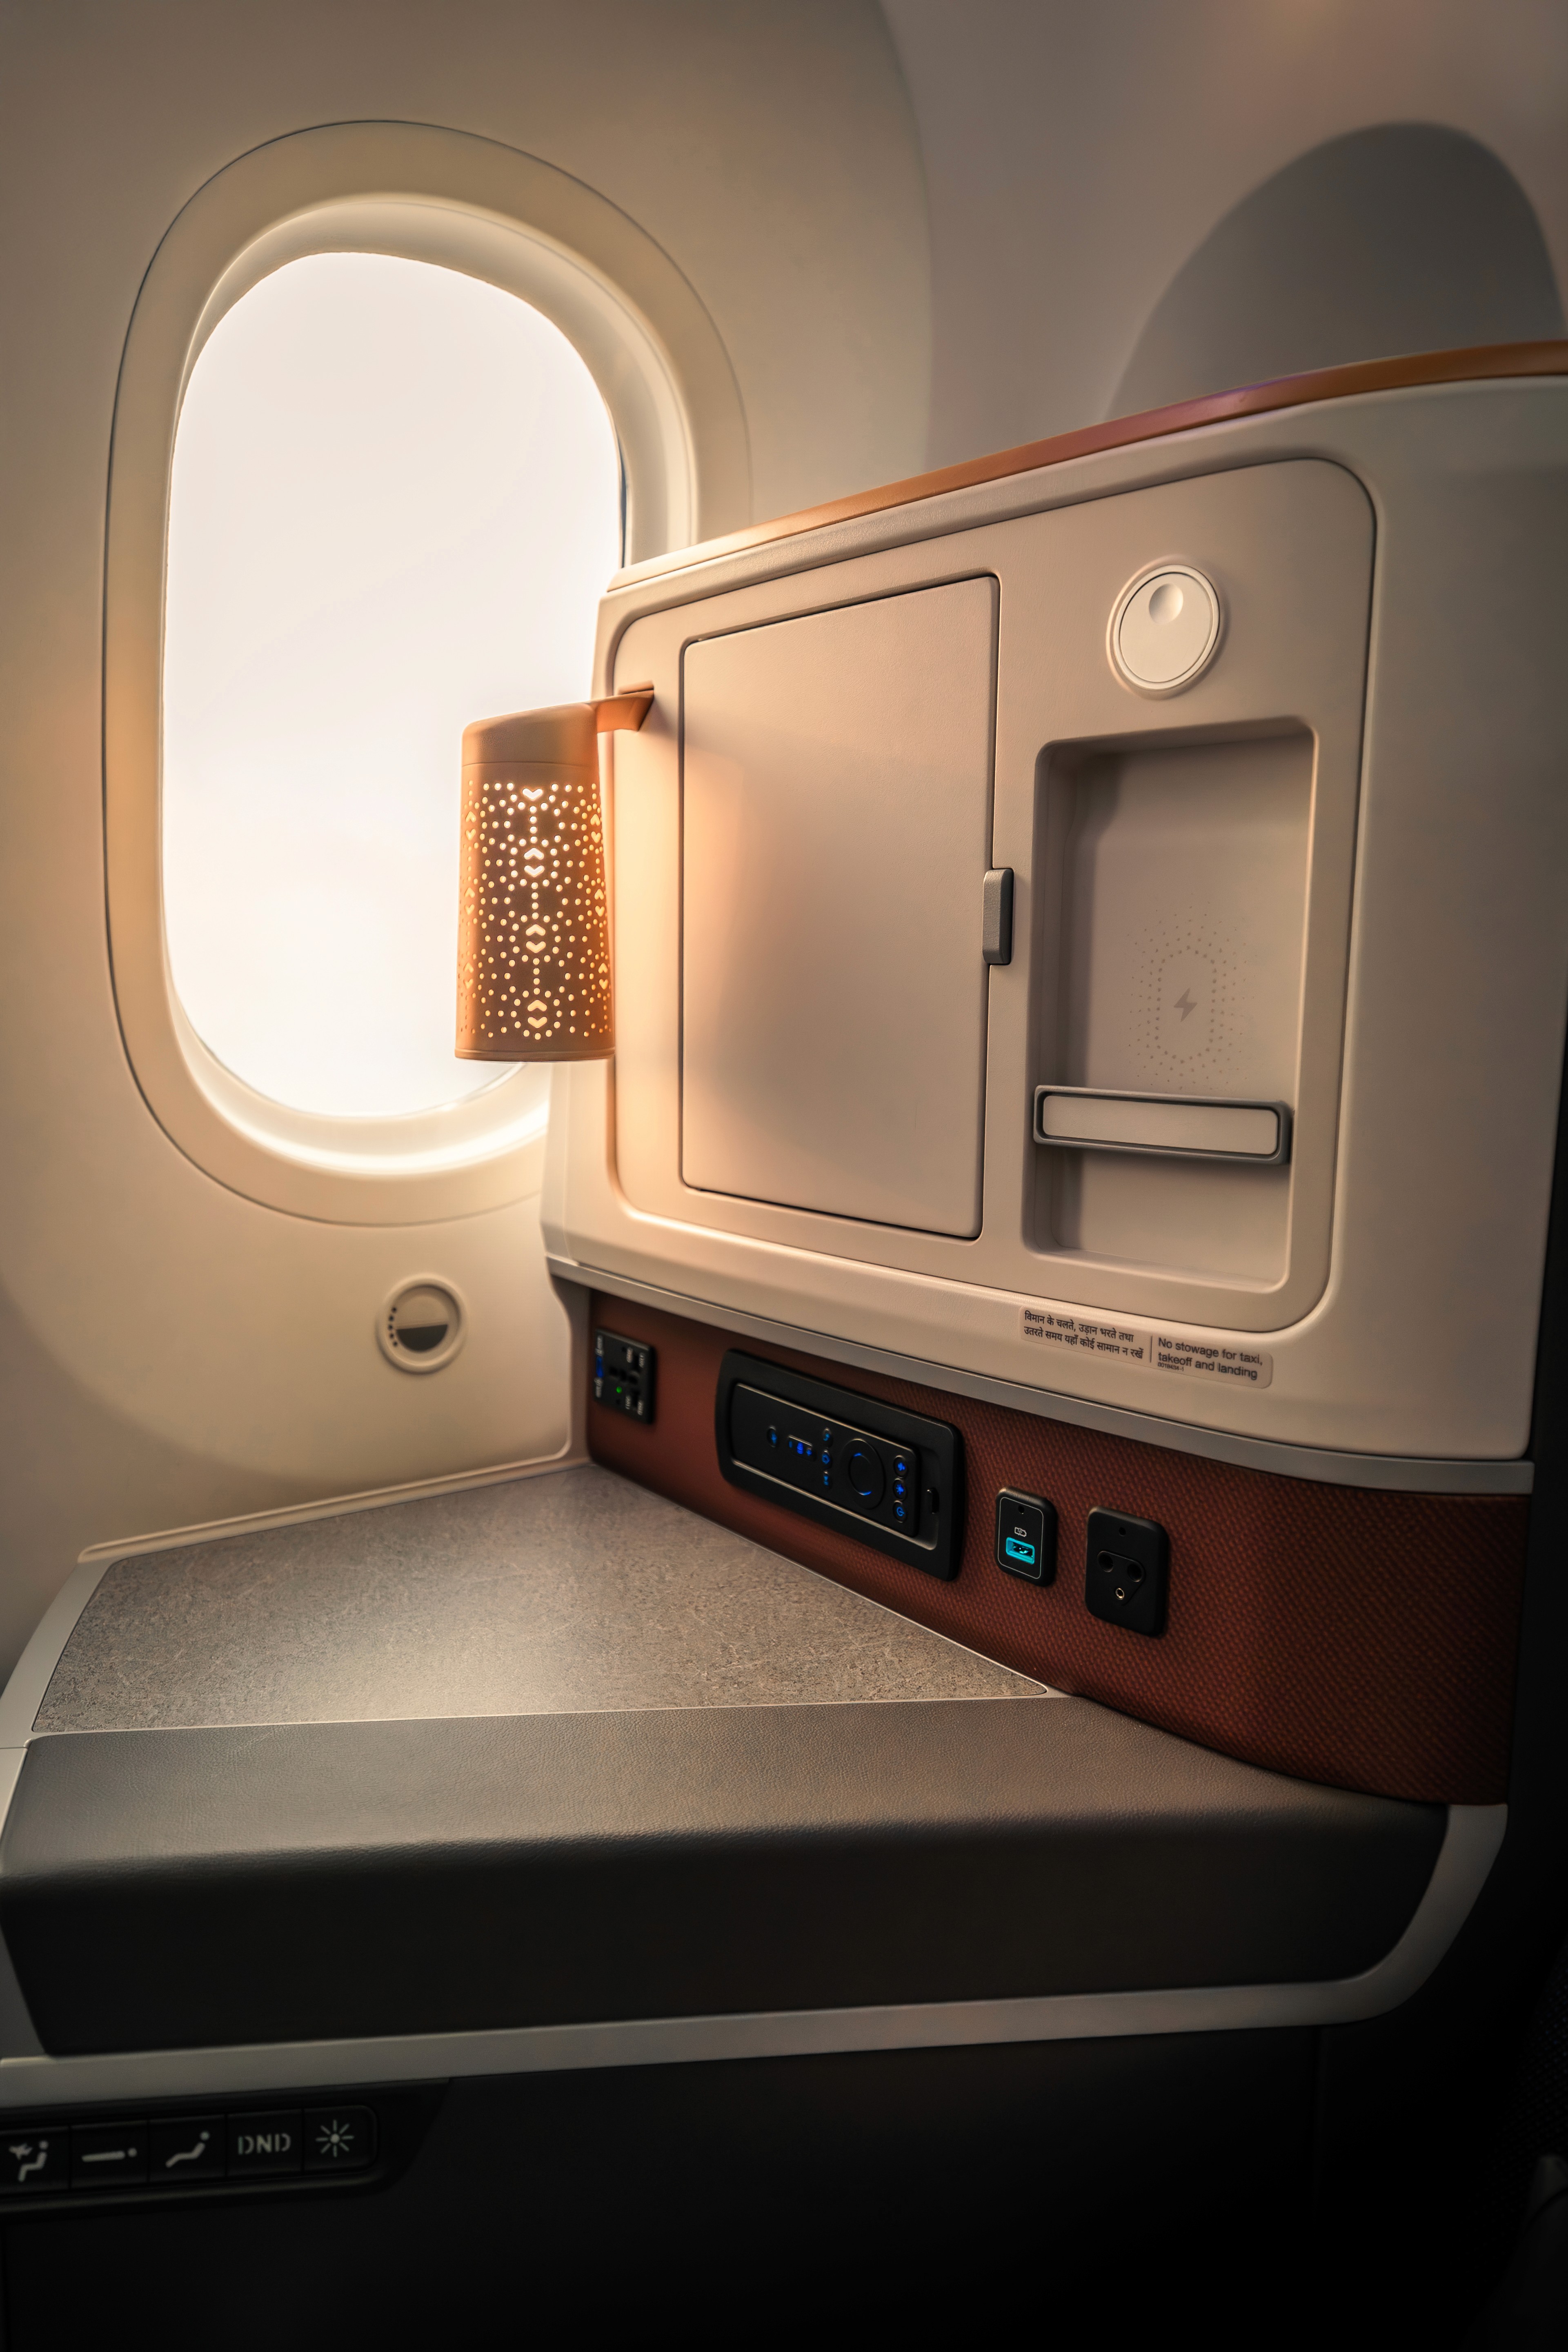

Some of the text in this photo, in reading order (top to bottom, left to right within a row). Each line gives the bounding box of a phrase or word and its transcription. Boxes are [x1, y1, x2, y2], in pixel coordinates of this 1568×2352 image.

[1025, 1310, 1134, 1342] विमान के चलते, उड़ान भरते तथा
[1024, 1326, 1144, 1359] उतरते समय यहाँ कोई सामान न रखें
[1159, 1337, 1263, 1365] No stowage for taxi,
[1158, 1352, 1258, 1381] takeoff and landing
[238, 2133, 291, 2155] DND
